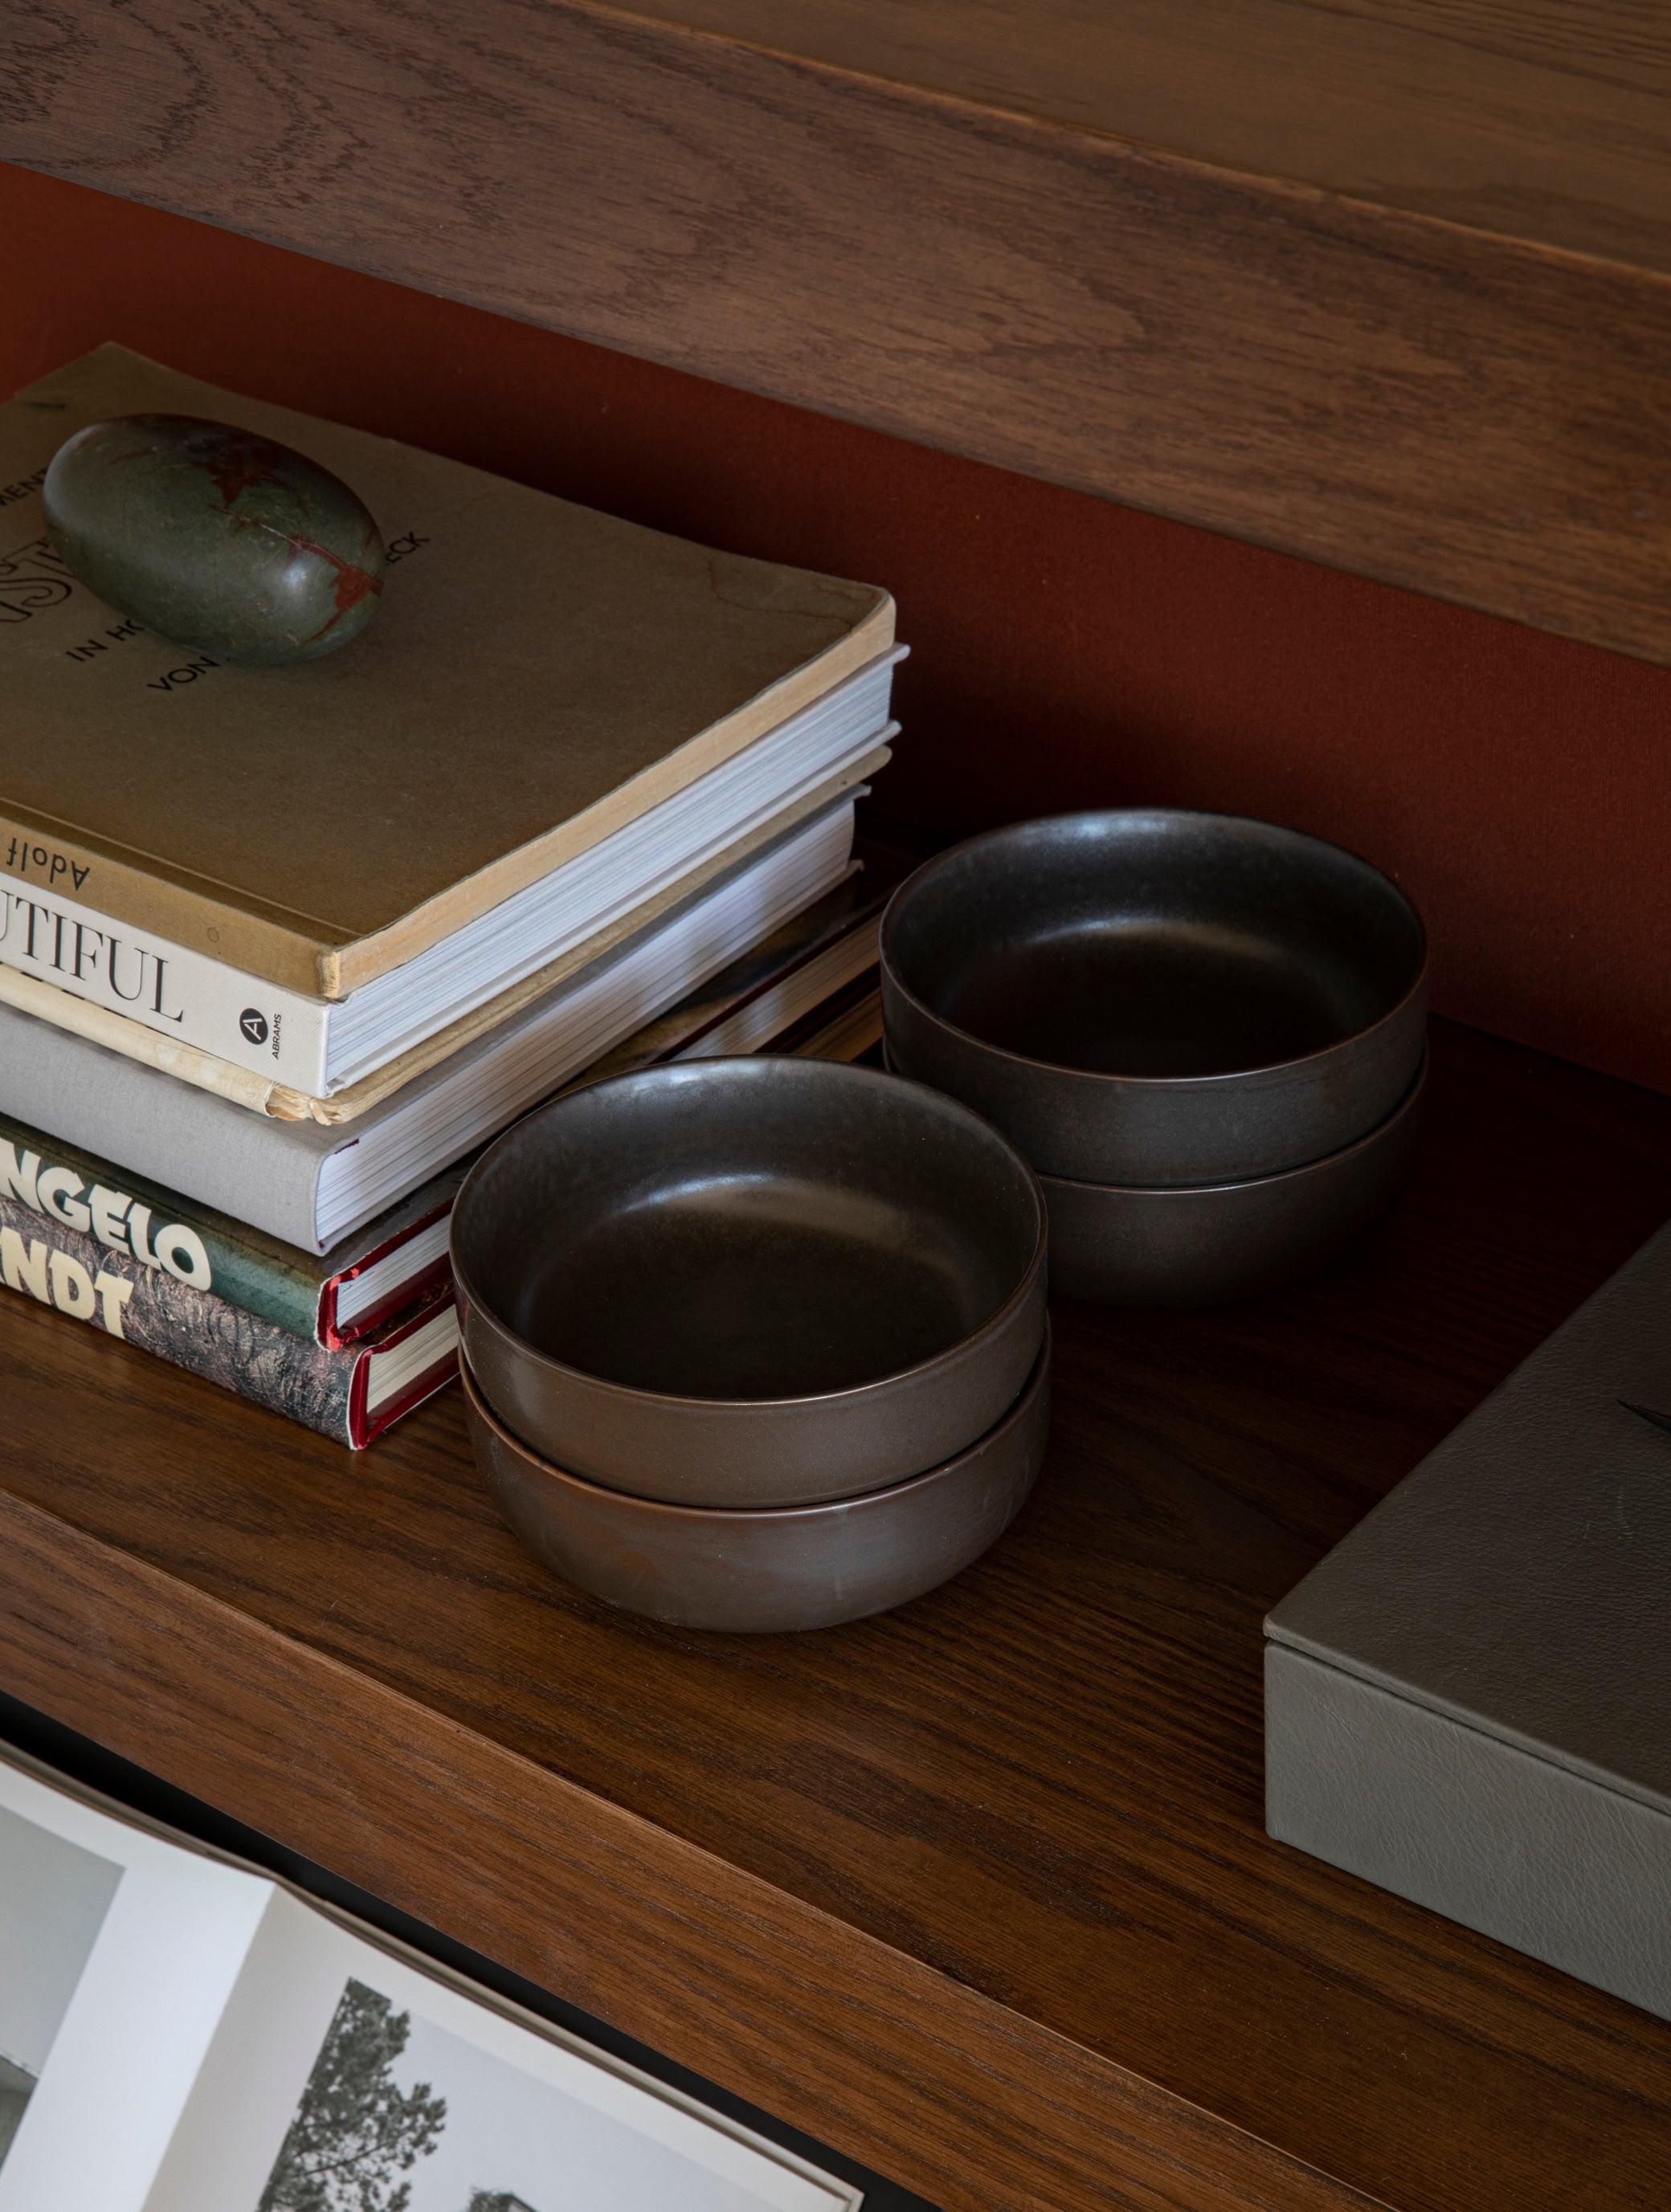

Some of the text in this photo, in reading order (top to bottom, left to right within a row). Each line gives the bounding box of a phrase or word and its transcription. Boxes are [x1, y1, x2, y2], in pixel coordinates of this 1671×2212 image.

[146, 531, 431, 691] VON ECK
[65, 639, 108, 678] IN
[6, 837, 90, 891] Adolf
[272, 1014, 281, 1059] ABRAMS
[0, 1226, 134, 1339] NDT
